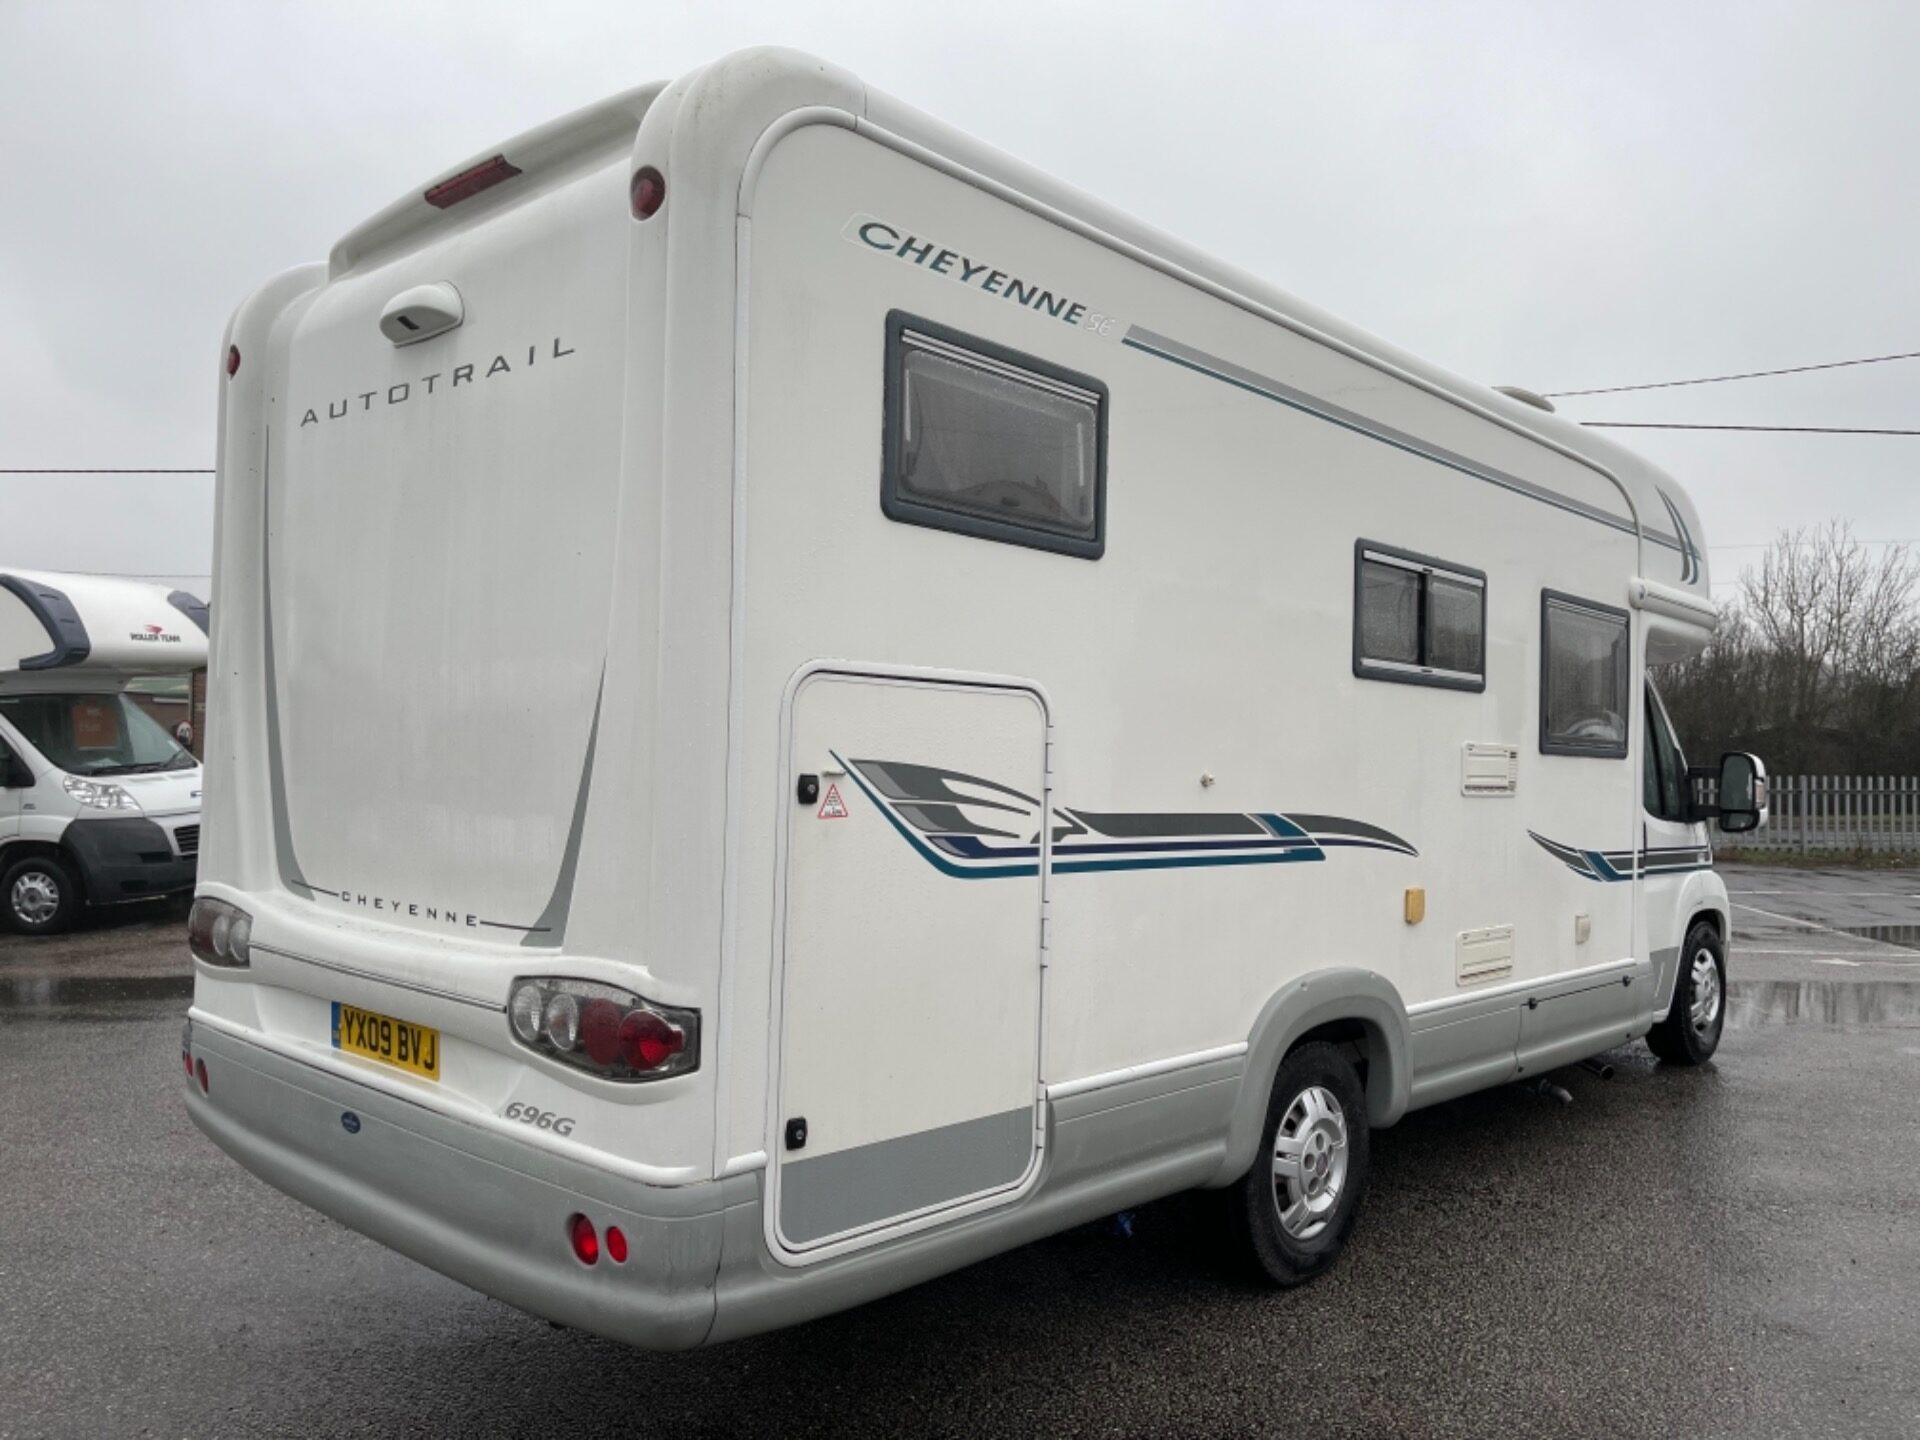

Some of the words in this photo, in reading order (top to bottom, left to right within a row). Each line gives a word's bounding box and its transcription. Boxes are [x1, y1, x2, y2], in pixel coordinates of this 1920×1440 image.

[858, 222, 1087, 325] CHEYENNE
[300, 337, 575, 427] AUTOTRAIL
[341, 891, 477, 926] CHEYENNE
[344, 1008, 391, 1055] YX09
[398, 1024, 435, 1071] BVJ
[505, 1101, 576, 1137] 696G
